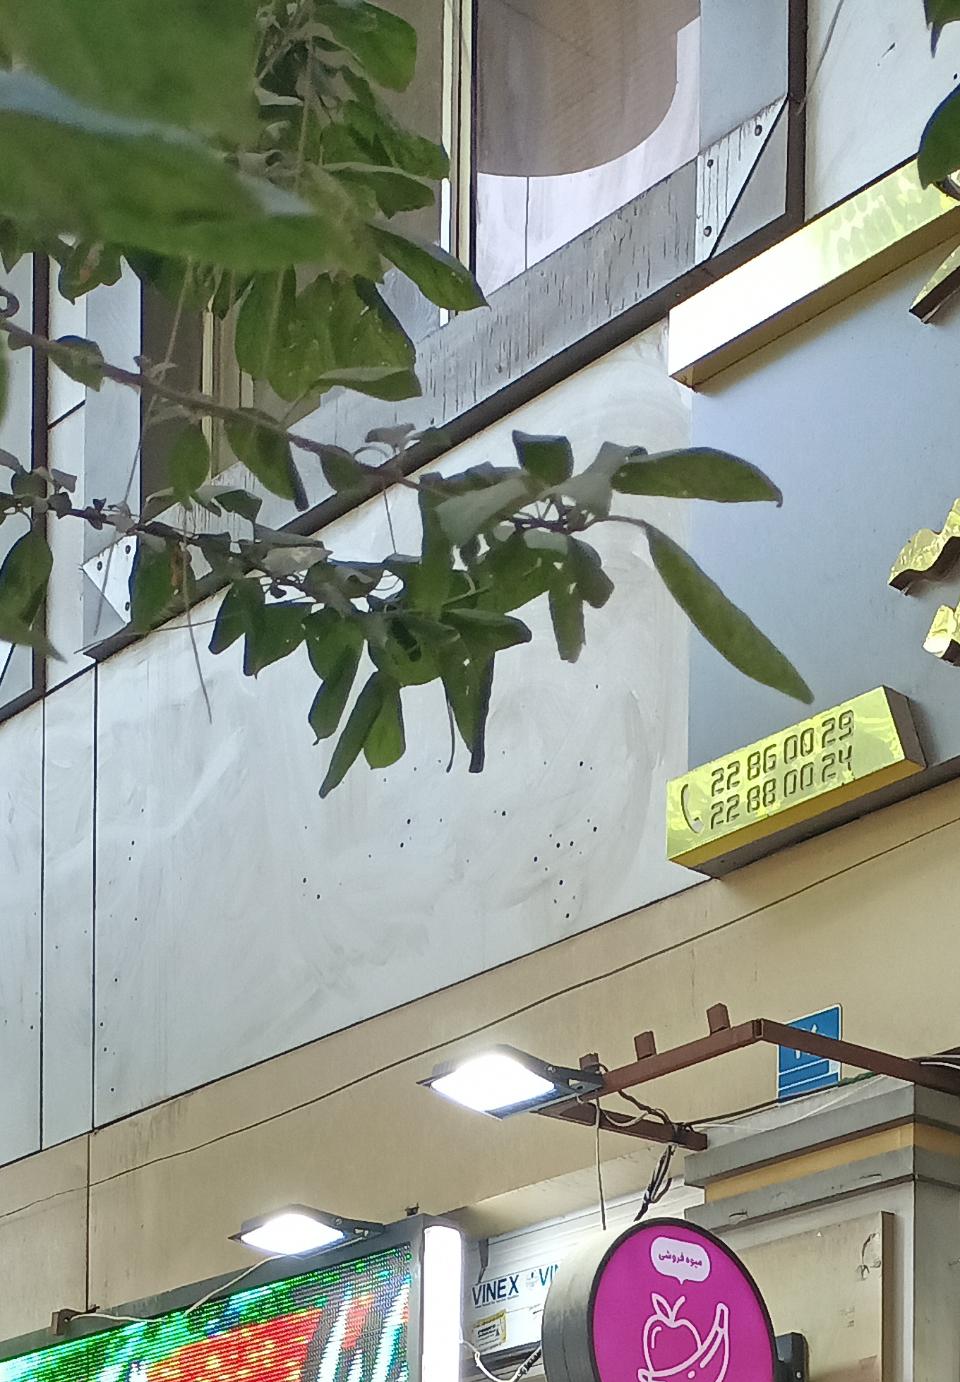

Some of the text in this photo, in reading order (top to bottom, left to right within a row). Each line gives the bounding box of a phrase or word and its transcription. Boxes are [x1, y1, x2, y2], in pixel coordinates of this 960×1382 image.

[711, 760, 741, 797] 22
[783, 727, 814, 765] 00
[821, 709, 855, 749] 29
[710, 745, 853, 830] 22 88 00 24
[658, 1250, 703, 1269] میوه فروشی
[472, 1274, 519, 1306] VINEX
